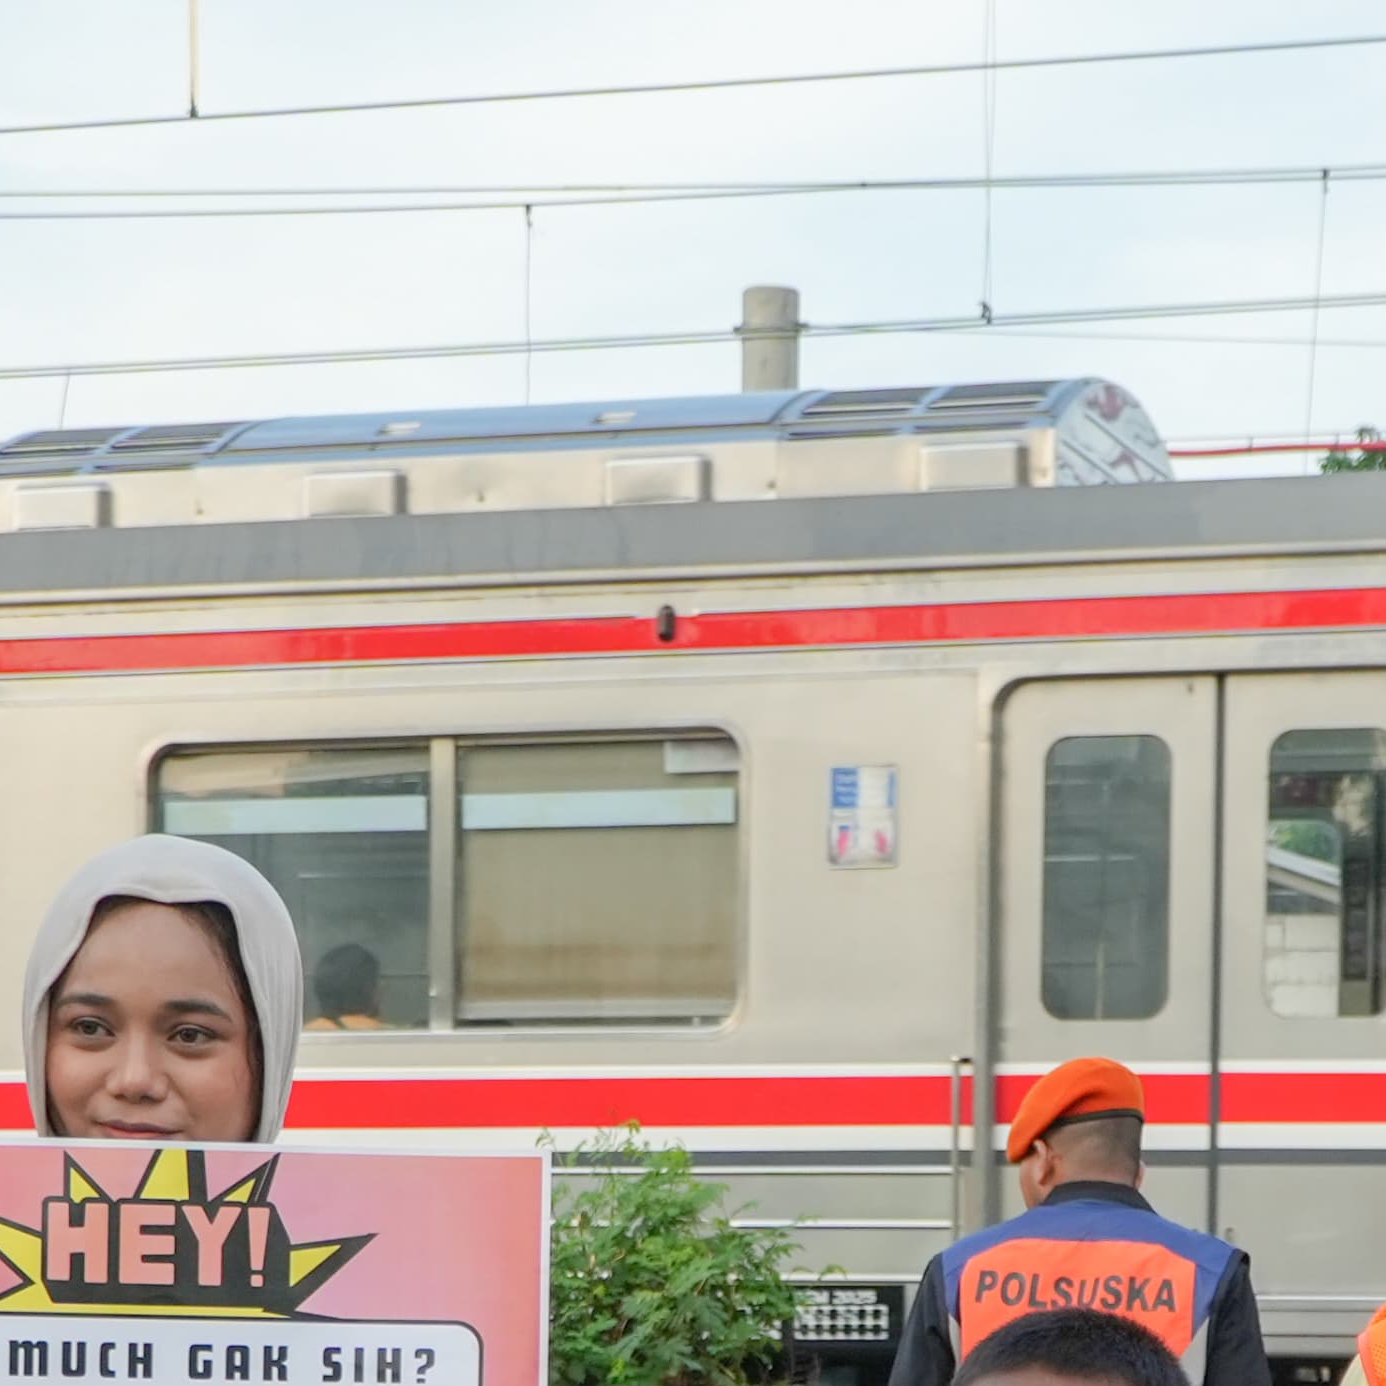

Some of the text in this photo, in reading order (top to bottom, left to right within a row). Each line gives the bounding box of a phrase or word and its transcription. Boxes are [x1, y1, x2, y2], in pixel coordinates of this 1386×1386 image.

[46, 1202, 271, 1288] HEY!
[975, 1269, 1176, 1313] POLSUSKA
[10, 1340, 154, 1379] MUCH
[188, 1344, 290, 1381] GAK
[322, 1346, 437, 1384] SIH?
